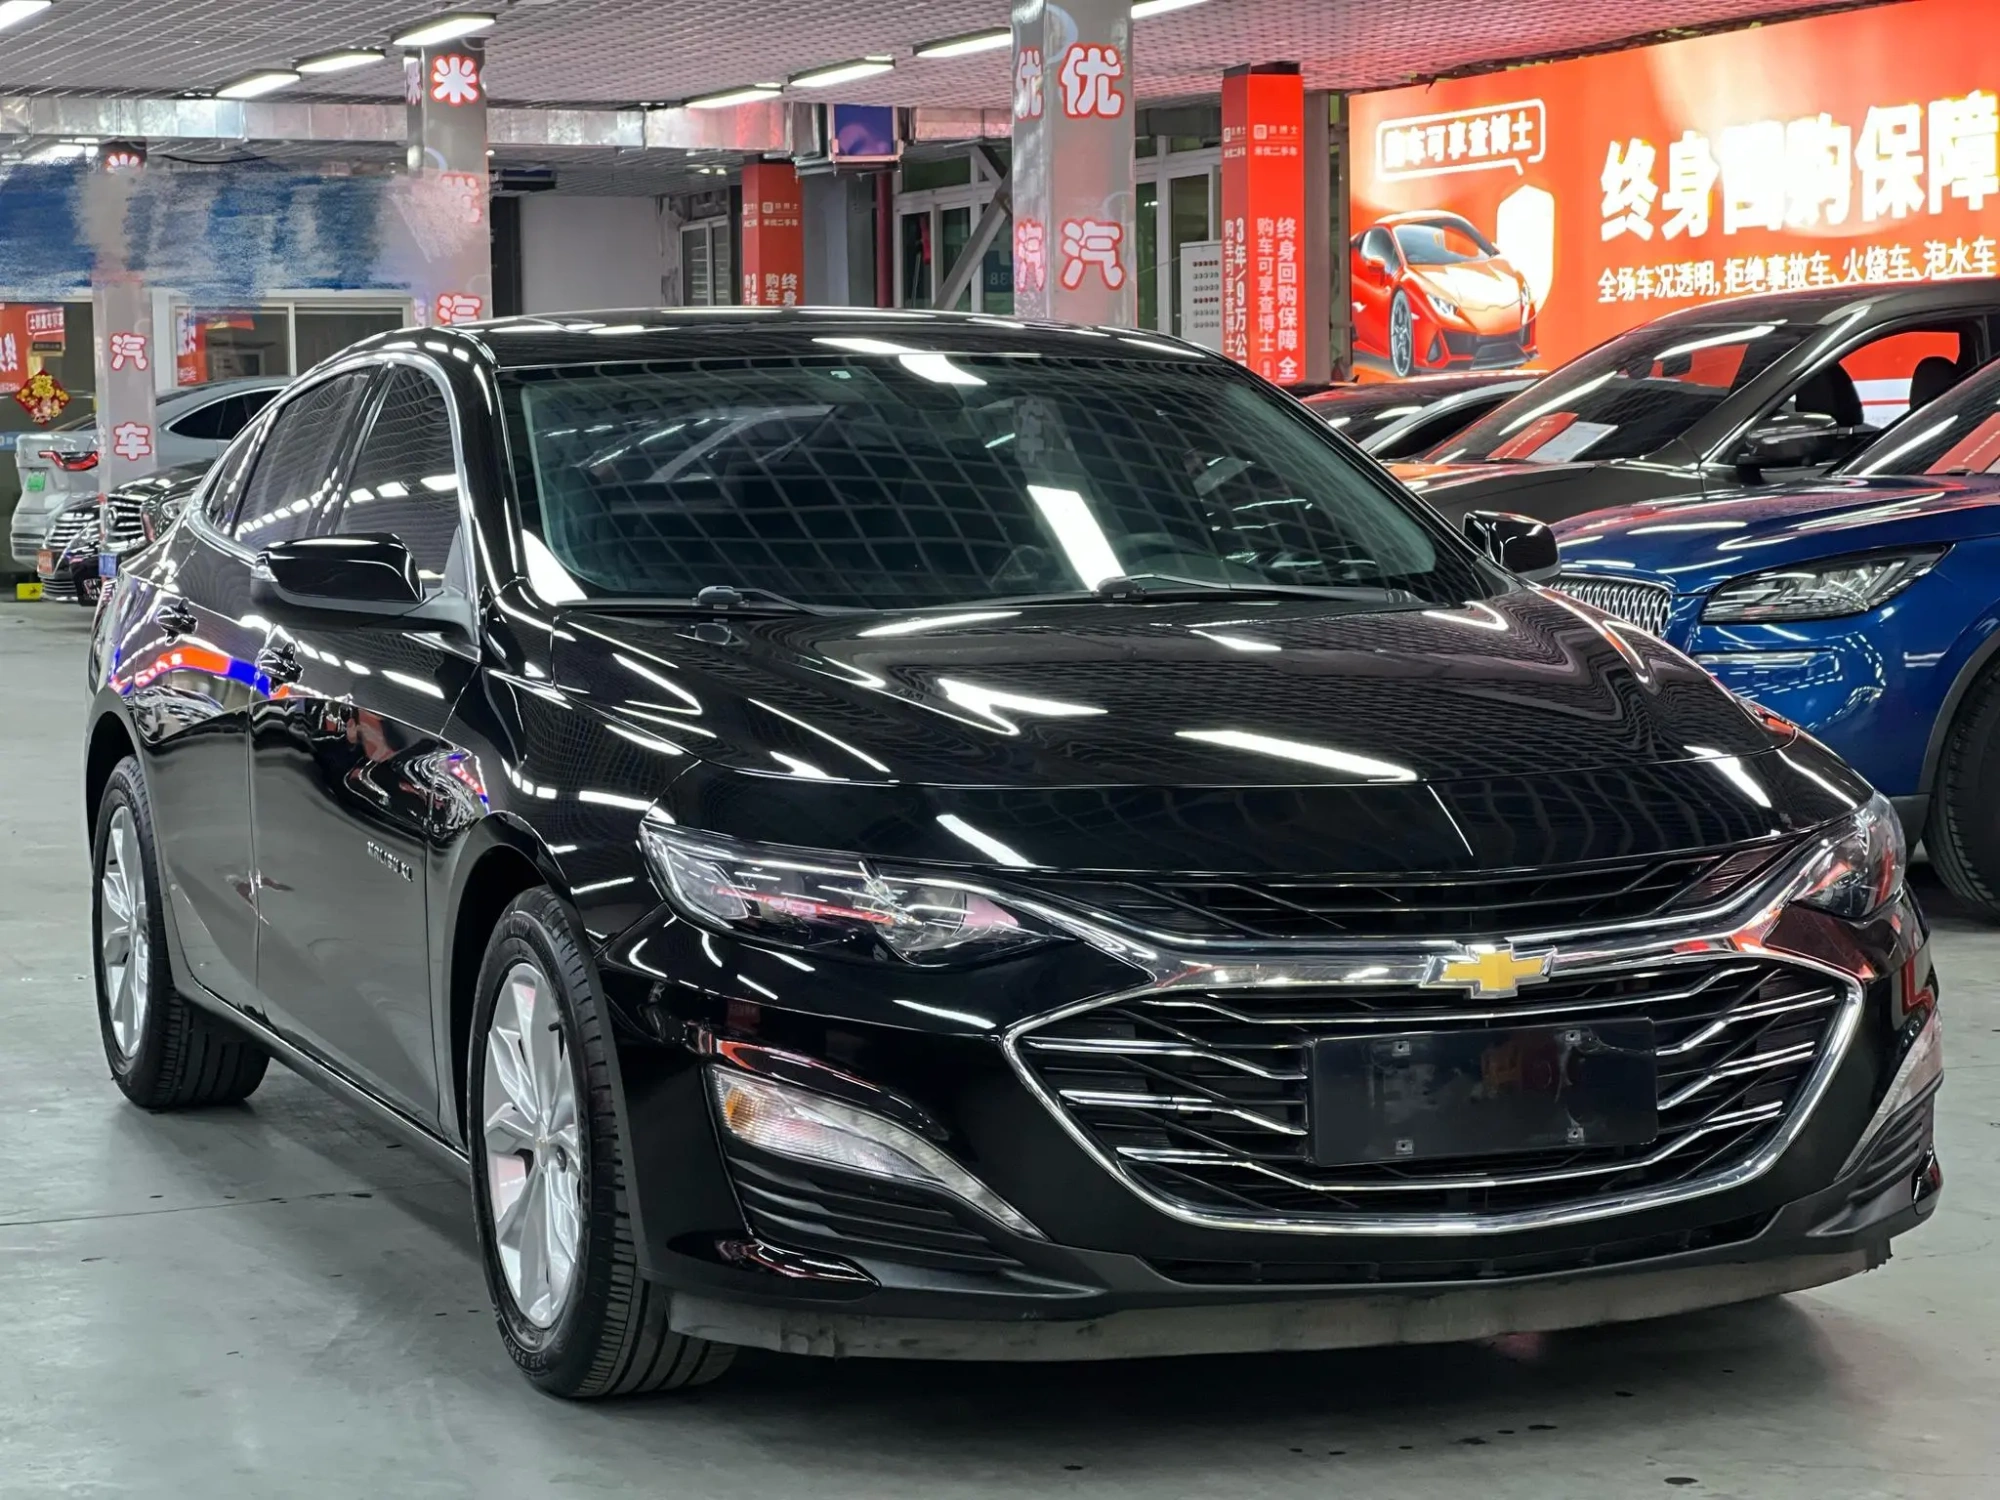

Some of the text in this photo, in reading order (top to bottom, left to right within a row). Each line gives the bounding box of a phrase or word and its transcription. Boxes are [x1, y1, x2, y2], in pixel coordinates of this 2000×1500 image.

[1058, 44, 1126, 291] 优 汽
[1257, 217, 1276, 353] 购车可享查博士
[1276, 217, 1298, 351] 终身回购保障
[110, 332, 152, 461] 汽 车
